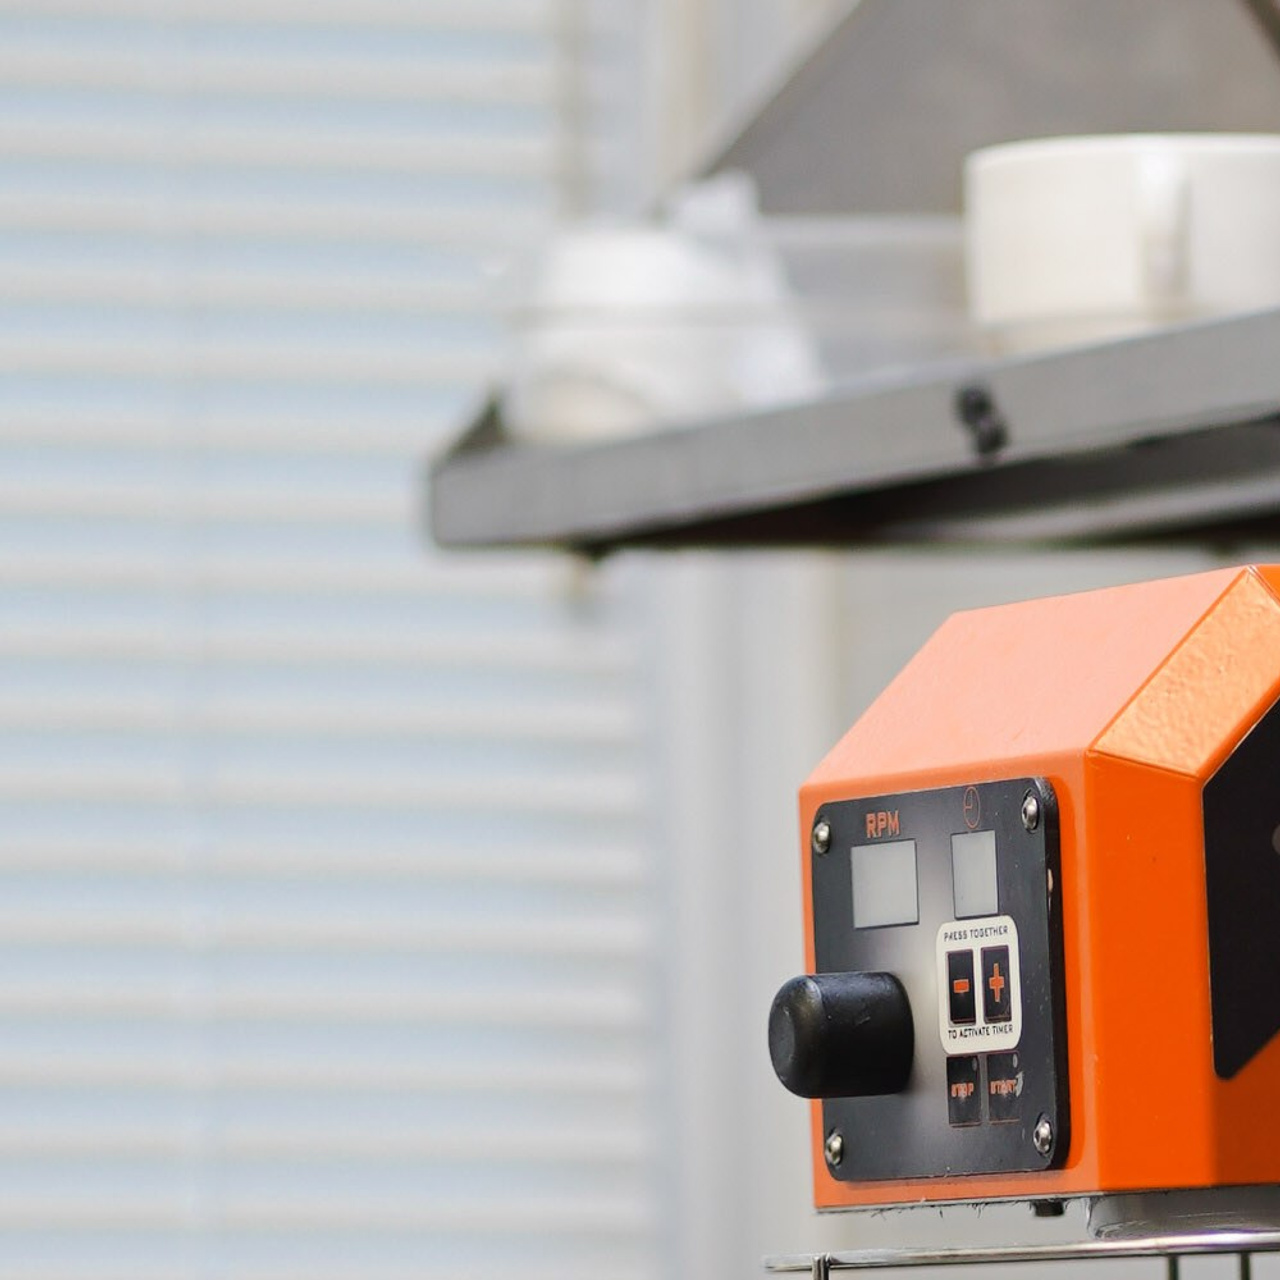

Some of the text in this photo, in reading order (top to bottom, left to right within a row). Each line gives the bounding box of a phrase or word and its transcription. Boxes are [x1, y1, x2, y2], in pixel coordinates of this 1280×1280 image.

[866, 810, 900, 838] RPM
[944, 925, 1008, 941] PRESS TOGETHER
[948, 1024, 1013, 1039] TO ACTIVATE TIMER
[951, 1082, 974, 1097] STOP
